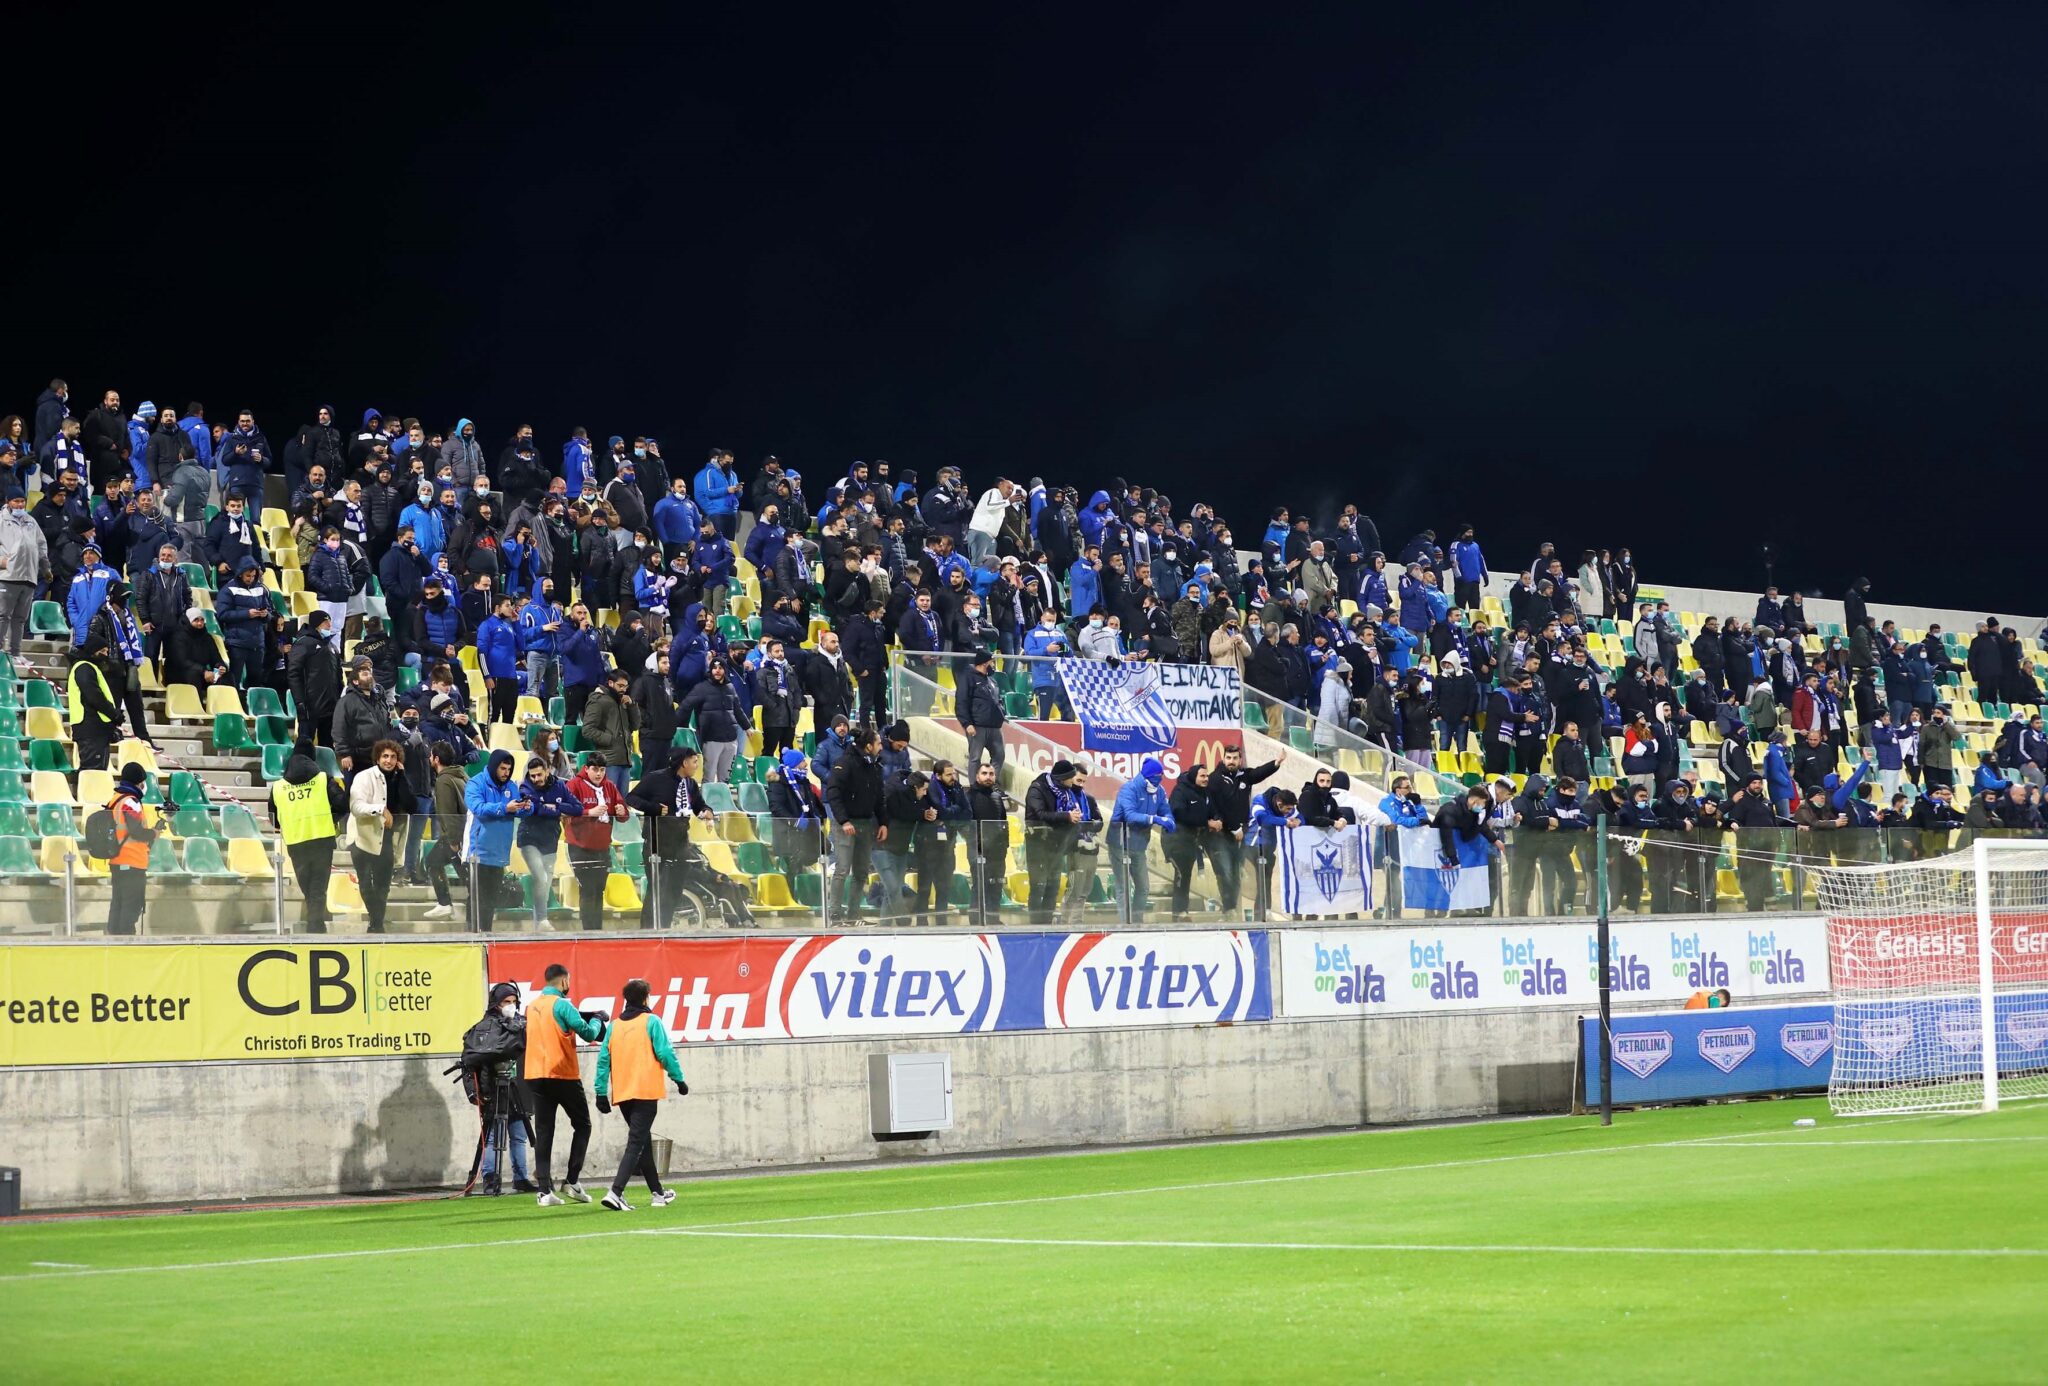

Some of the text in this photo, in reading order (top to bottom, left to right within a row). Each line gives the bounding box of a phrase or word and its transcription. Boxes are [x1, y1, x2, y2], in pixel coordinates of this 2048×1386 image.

[1004, 743, 1181, 779] Mconal's
[288, 788, 312, 801] 037
[1314, 942, 1354, 972] bet
[1410, 939, 1445, 969] bet
[1501, 937, 1535, 966] bet
[1588, 935, 1619, 963] bt
[1671, 932, 1701, 959] bet
[1748, 930, 1776, 957] bet
[374, 969, 432, 987] create
[1082, 944, 1219, 1012] vitex
[1411, 960, 1479, 1000] on alfa
[1503, 958, 1567, 996] on alfa
[1609, 954, 1651, 992] alfa
[1672, 951, 1729, 987] on alfa
[1749, 948, 1805, 984] on alfa
[238, 949, 357, 1016] CB
[810, 948, 966, 1020] vitex
[1314, 964, 1386, 1004] on alfa
[0, 993, 190, 1024] eate Better
[375, 990, 432, 1012] better
[244, 1032, 432, 1051] Christofi Bros Trading LTD
[1618, 1038, 1667, 1053] PETROLINA
[1704, 1033, 1750, 1049] PETROLINA
[1786, 1028, 1829, 1043] PETROLINA
